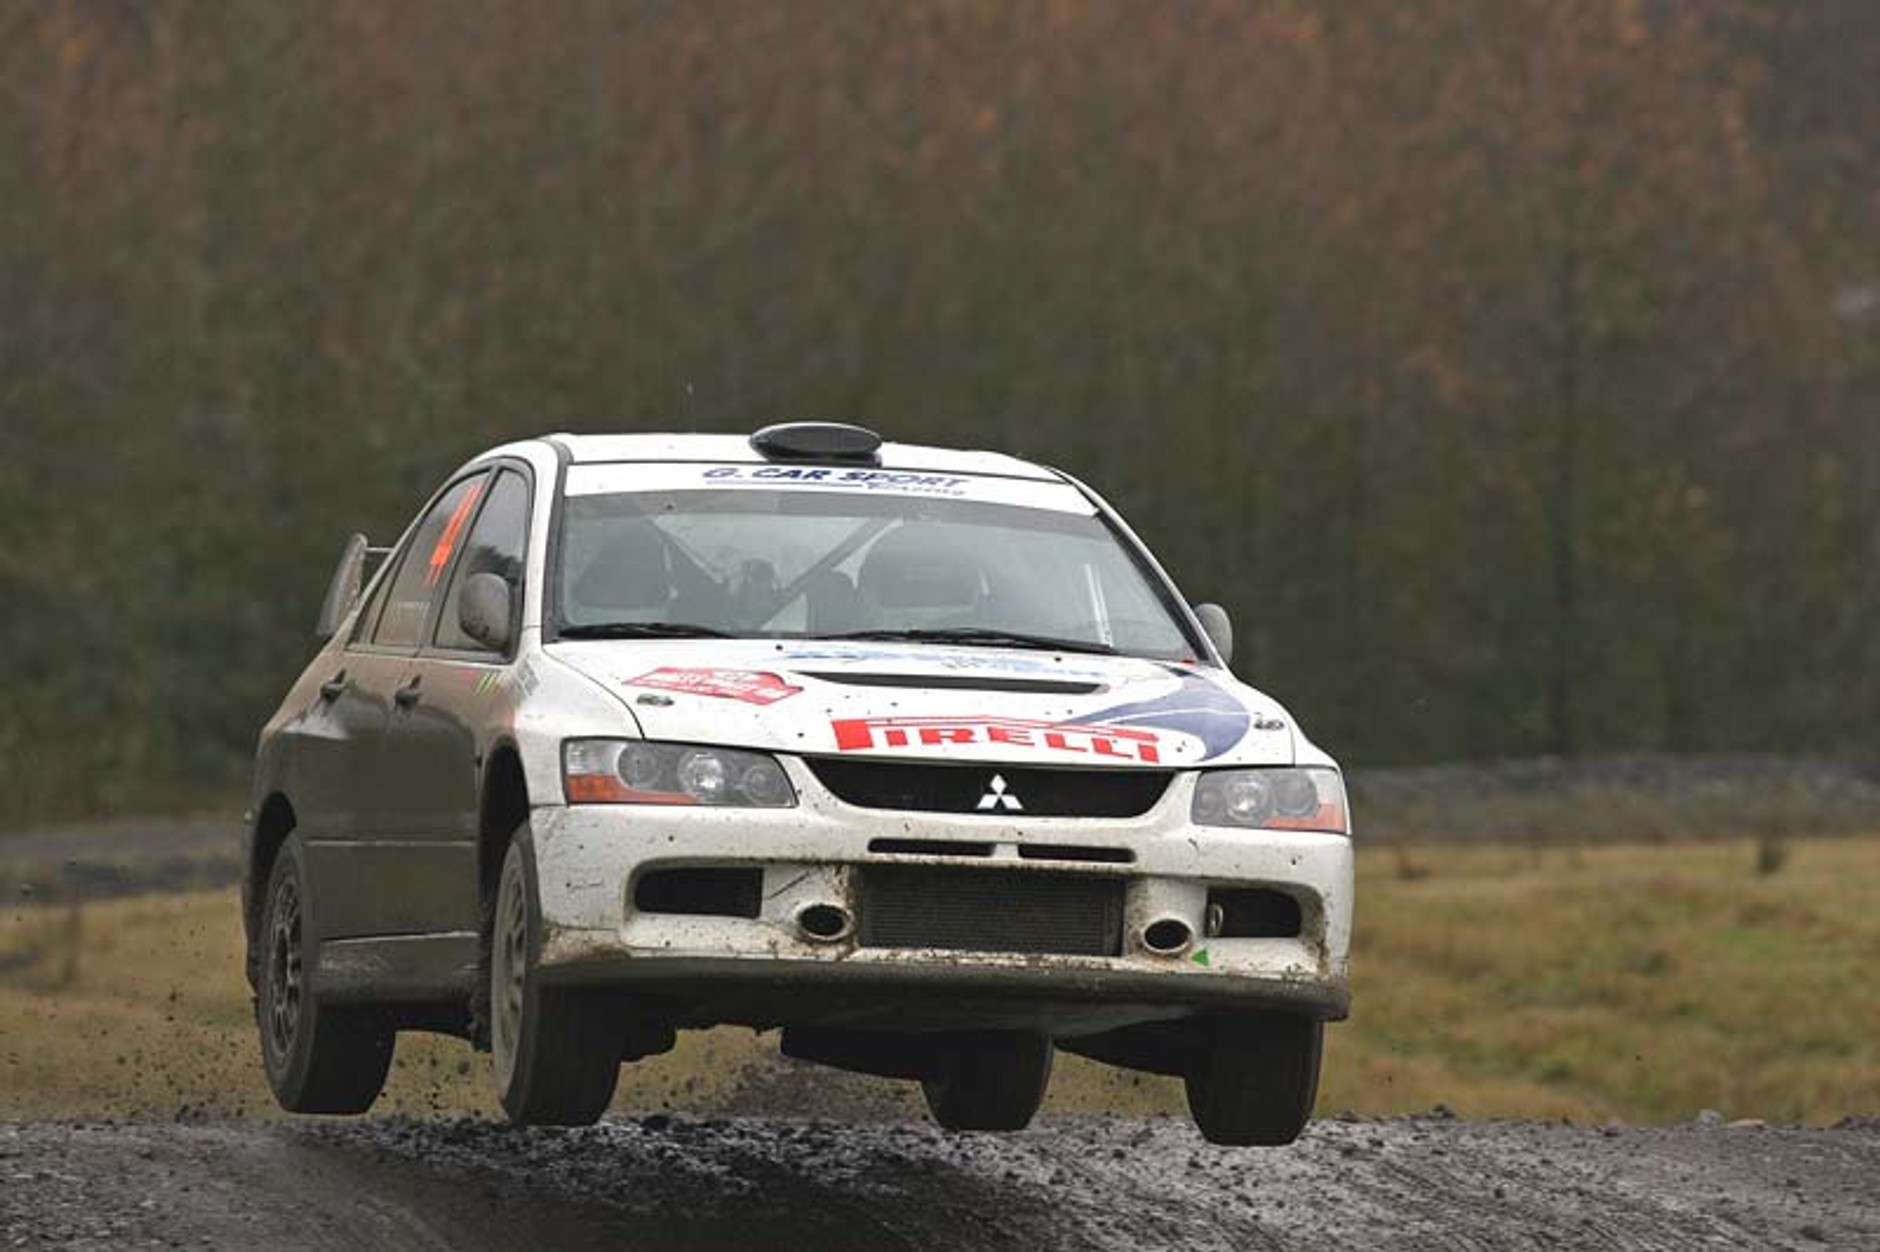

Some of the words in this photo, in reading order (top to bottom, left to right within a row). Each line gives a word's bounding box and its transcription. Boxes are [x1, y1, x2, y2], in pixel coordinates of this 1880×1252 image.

[752, 468, 830, 480] CAR
[839, 471, 970, 487] SPORT
[832, 716, 1159, 763] PIRELLI
